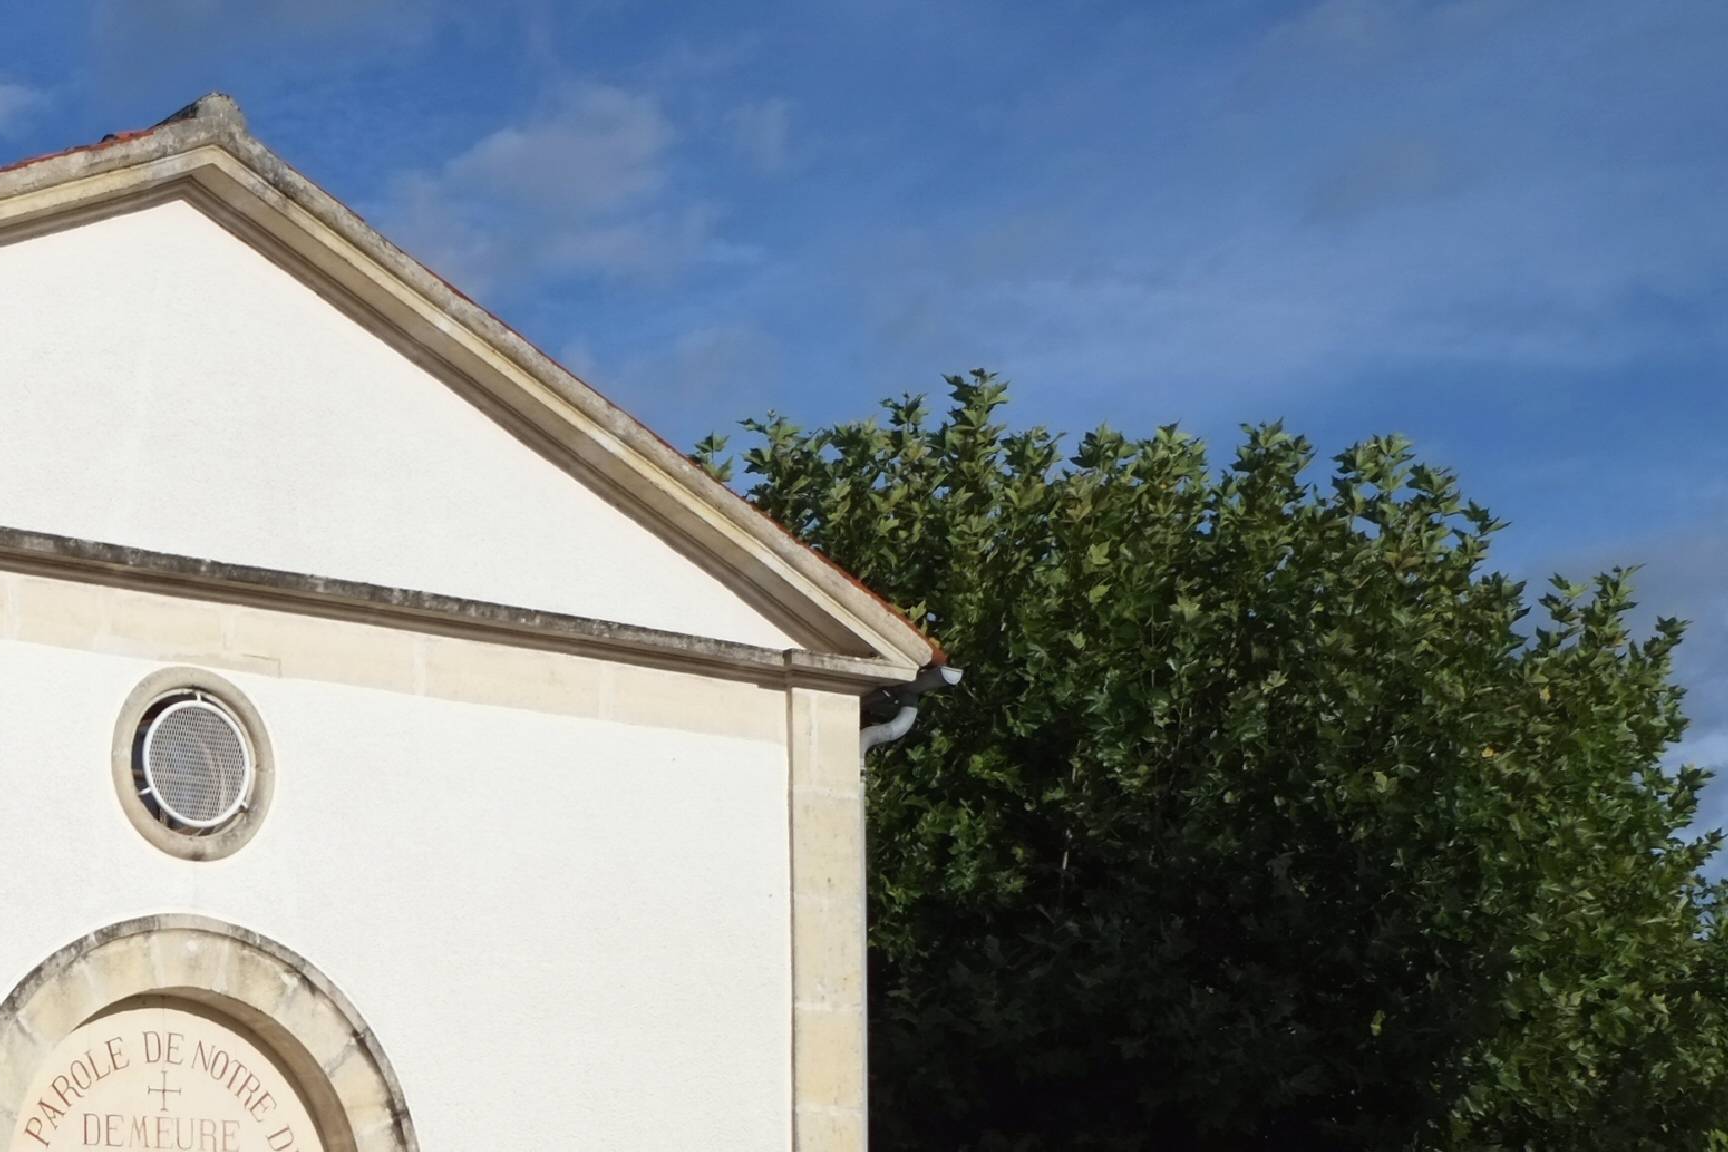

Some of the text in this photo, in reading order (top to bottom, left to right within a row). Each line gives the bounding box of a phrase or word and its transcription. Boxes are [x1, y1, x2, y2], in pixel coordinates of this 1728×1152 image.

[24, 1036, 130, 1148] PAROLE
[142, 1031, 184, 1065] DE
[191, 1040, 277, 1123] NOTRE
